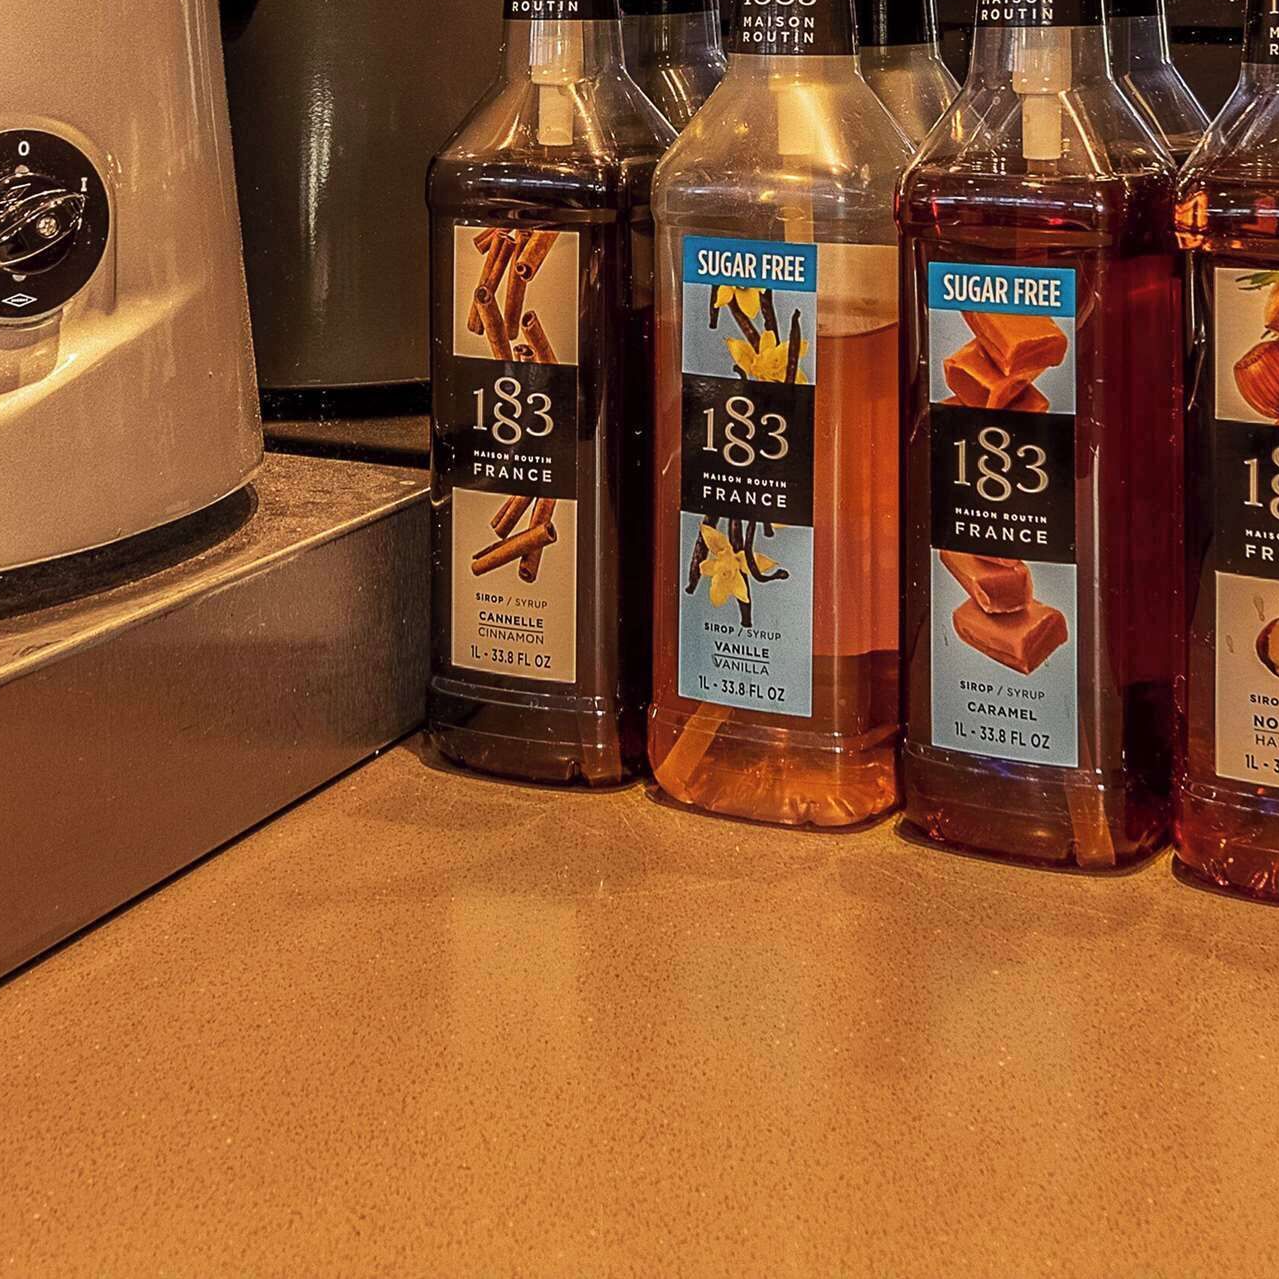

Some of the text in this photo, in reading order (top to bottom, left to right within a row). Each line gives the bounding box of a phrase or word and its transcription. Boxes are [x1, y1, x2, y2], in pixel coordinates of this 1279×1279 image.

[512, 1, 578, 12] ROUTIN
[982, 8, 1052, 20] ROUTIN
[744, 16, 814, 28] MAISON
[743, 30, 814, 43] ROUTIN
[698, 250, 804, 282] SUGAR FREE
[943, 273, 1061, 306] SUGAR FREE
[473, 377, 554, 444] 1883
[702, 396, 789, 467] 1883
[474, 450, 551, 463] MAISON ROUTIN
[954, 427, 1049, 501] 1883
[474, 463, 551, 482] FRANCE
[704, 472, 786, 488] MAISON ROUTIN
[704, 486, 786, 507] FRANCE
[955, 508, 1047, 523] MAISON ROUTIN
[955, 522, 1047, 544] FRANCE
[476, 592, 547, 608] SIROP SYRUP
[480, 611, 543, 628] CANNELLE
[479, 627, 543, 644] CINNAMON
[705, 622, 781, 640] SIROP SYRUP
[471, 645, 551, 668] 1L 33.8 FL OZ
[715, 641, 768, 658] VANILLE
[714, 658, 768, 675] VANILLA
[699, 675, 784, 701] 1L 33.8 FL OZ
[960, 681, 1044, 699] SIROP SYRUP
[968, 702, 1037, 721] CARAMEL
[955, 721, 1049, 749] 1L 33.8 FL OZ
[1245, 754, 1258, 769] 1L
